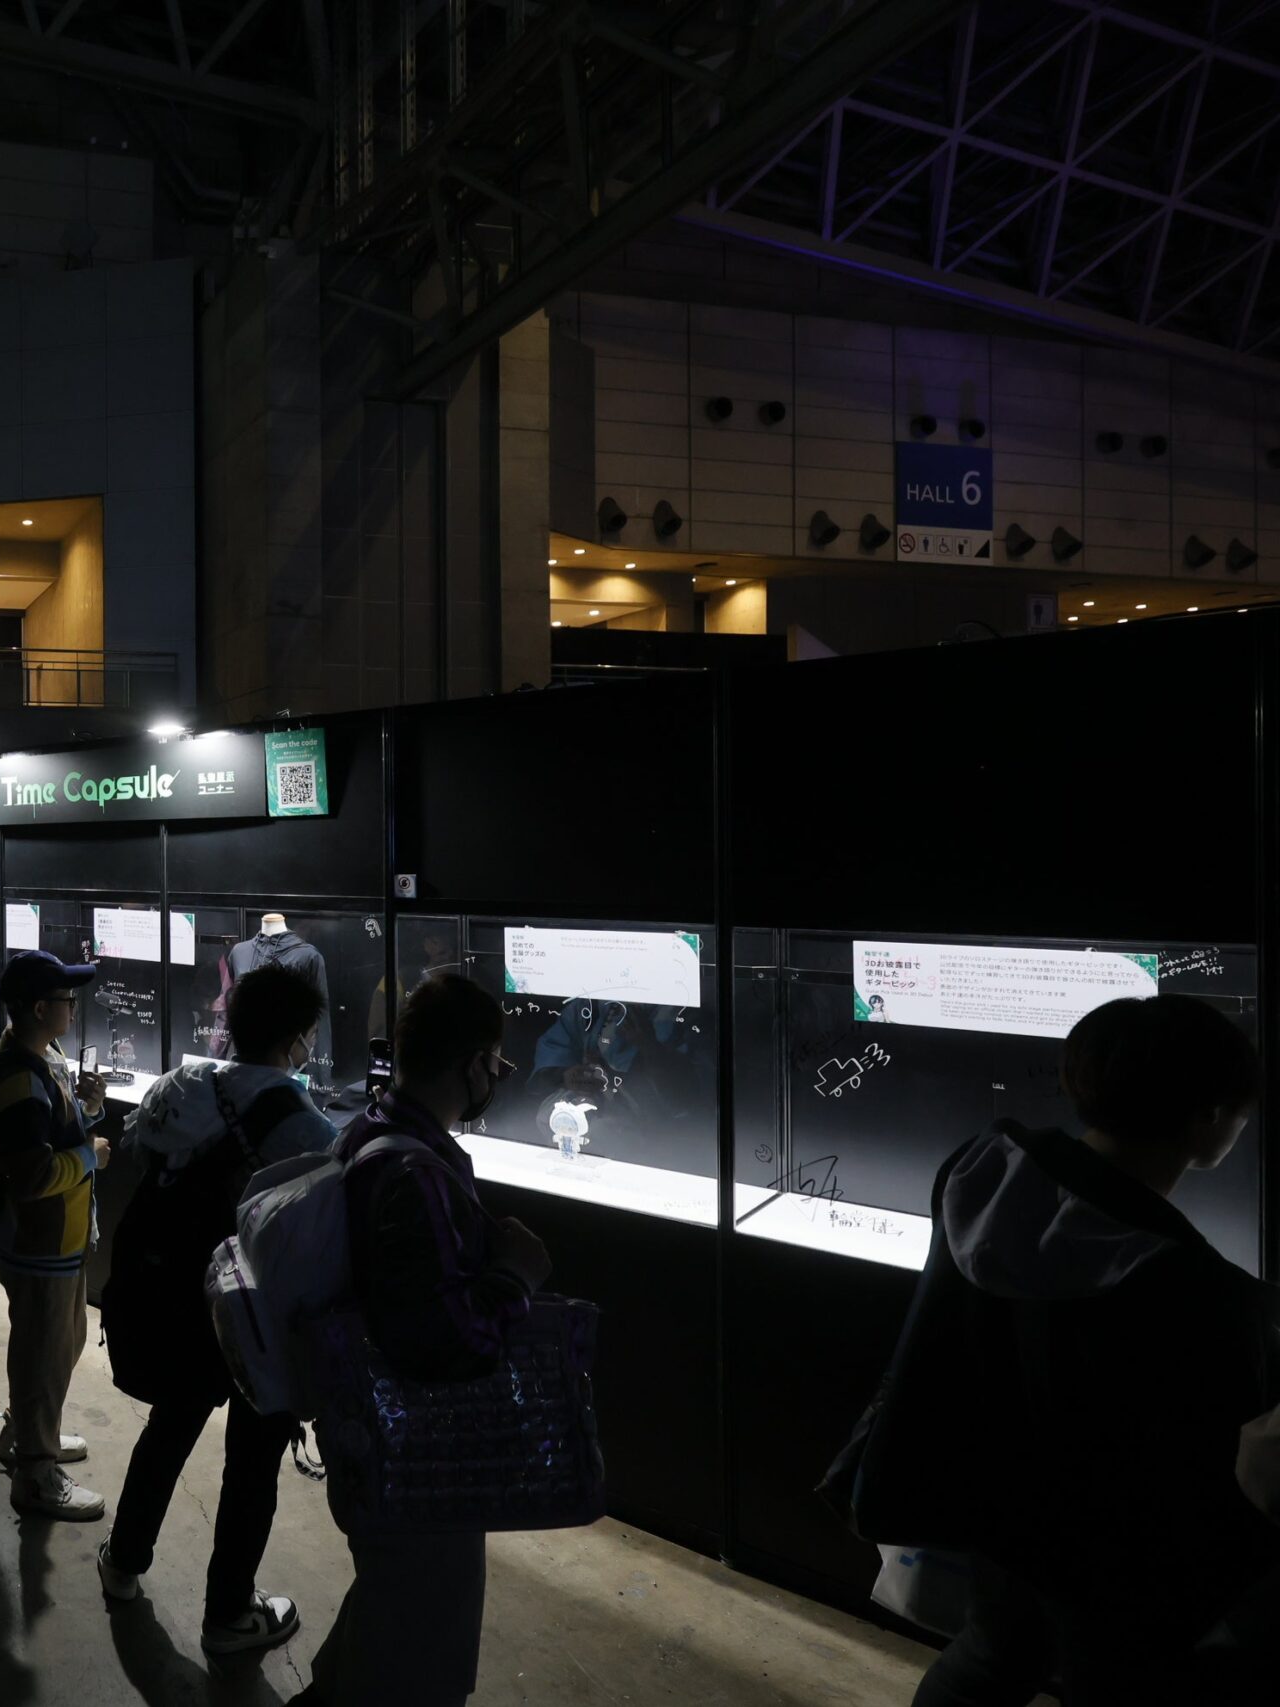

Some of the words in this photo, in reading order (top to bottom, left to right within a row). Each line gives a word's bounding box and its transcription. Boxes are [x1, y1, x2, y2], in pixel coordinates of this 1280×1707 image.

[906, 483, 955, 504] HALL
[961, 470, 982, 506] 6
[271, 742, 288, 750] Scan
[301, 738, 318, 746] code
[0, 776, 57, 809] Time
[63, 765, 180, 807] Capsule
[198, 784, 235, 794] コーナー
[864, 960, 921, 970] 3Dお披露目で
[865, 969, 900, 978] 使用した
[866, 978, 916, 988] ギターピック
